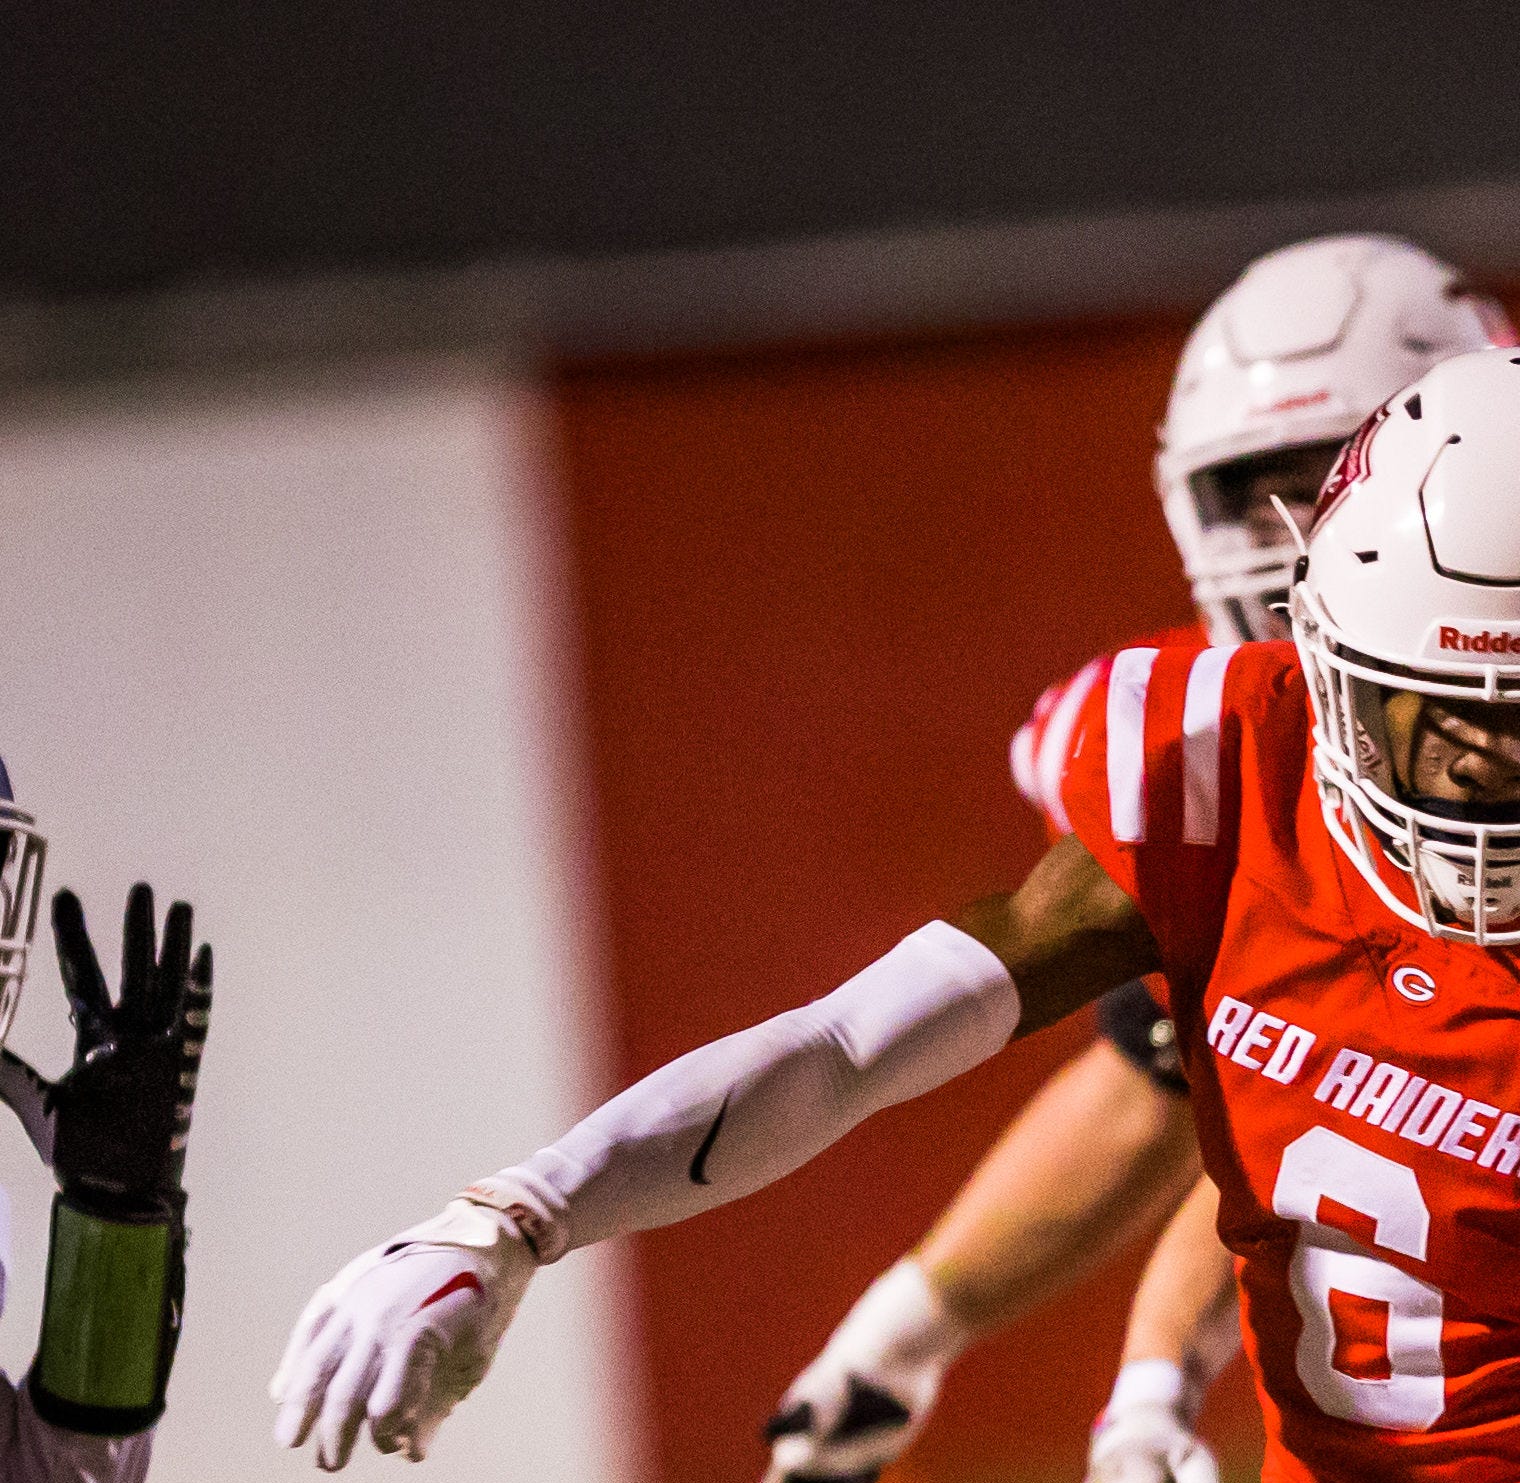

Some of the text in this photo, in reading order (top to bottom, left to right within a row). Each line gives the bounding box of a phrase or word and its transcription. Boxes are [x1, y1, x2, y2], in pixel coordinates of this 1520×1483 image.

[1392, 966, 1436, 1002] G
[1207, 995, 1317, 1085] RED
[1272, 1125, 1445, 1432] 6
